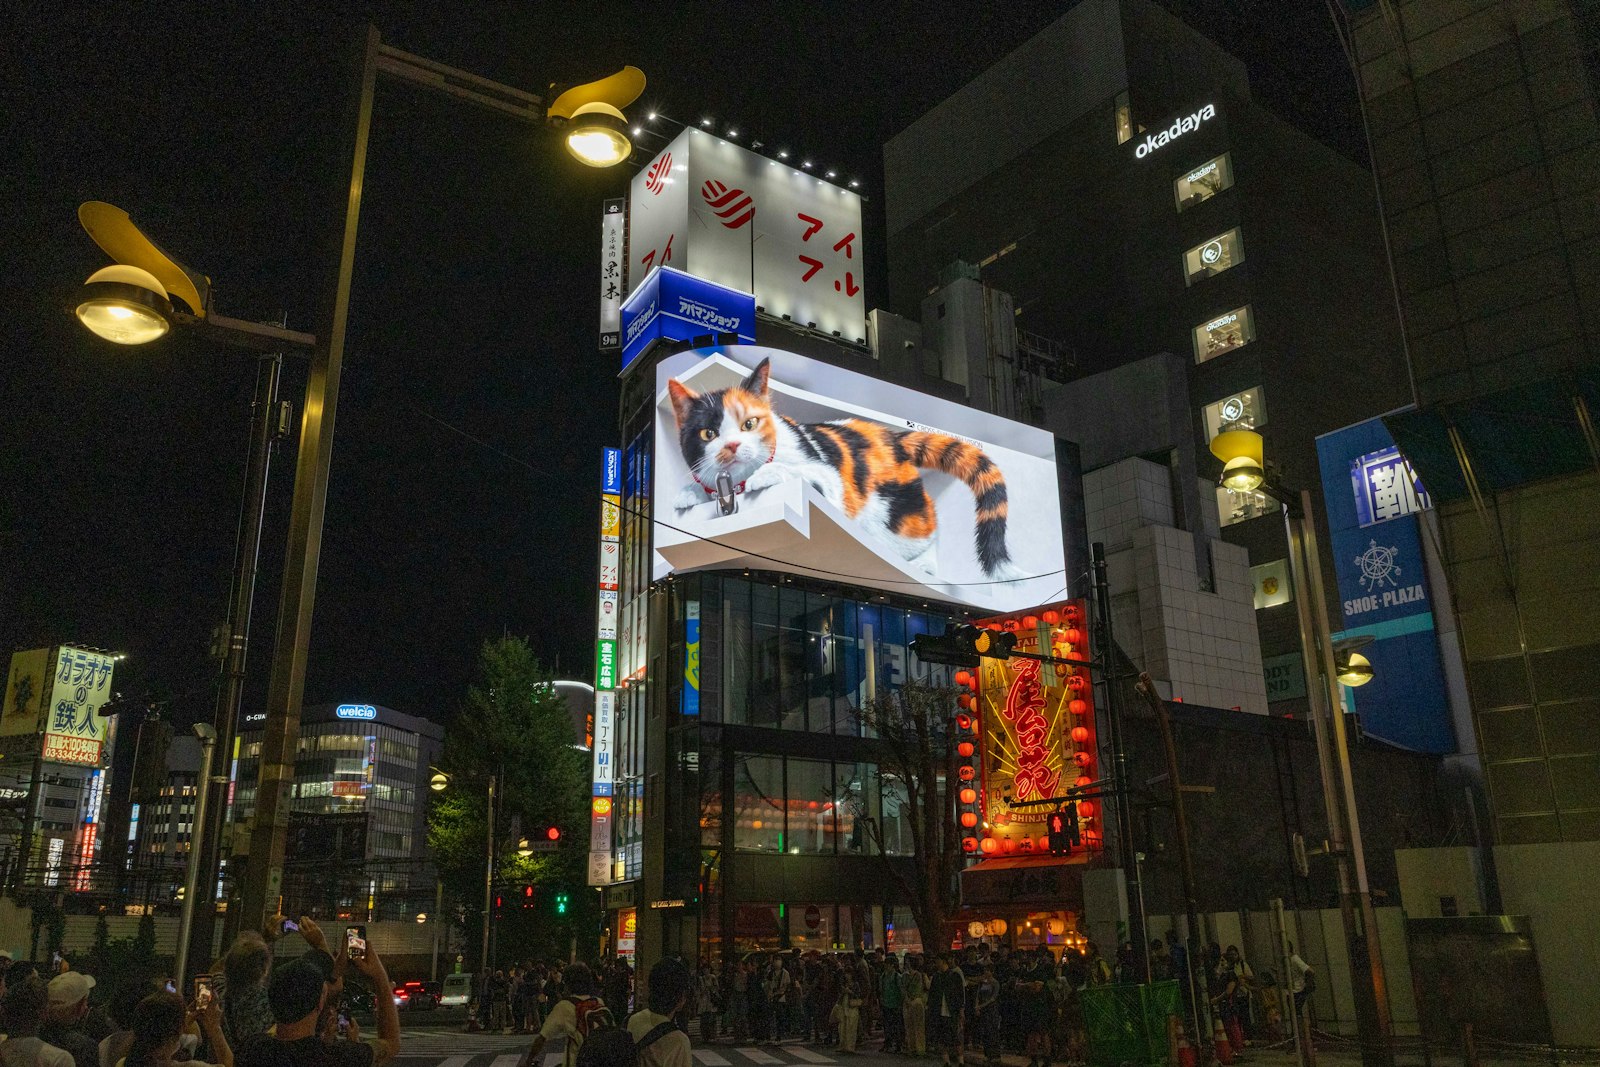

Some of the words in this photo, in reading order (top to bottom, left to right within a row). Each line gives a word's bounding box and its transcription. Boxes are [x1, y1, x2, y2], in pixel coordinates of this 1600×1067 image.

[1135, 104, 1216, 159] okadaya
[1187, 163, 1216, 182] okadaya
[797, 213, 855, 259] アイ
[602, 261, 620, 300] 黒木
[799, 255, 860, 298] フル
[679, 301, 740, 330] アパマンショップ
[1369, 460, 1427, 519] 靴
[604, 582, 614, 590] 4F
[57, 649, 112, 691] カラオケ
[600, 642, 613, 689] 宝石広場
[75, 685, 88, 706] の
[340, 706, 373, 718] welcia
[53, 700, 98, 737] 鉄人
[599, 785, 608, 794] 1F
[1011, 812, 1049, 824] SHINJU
